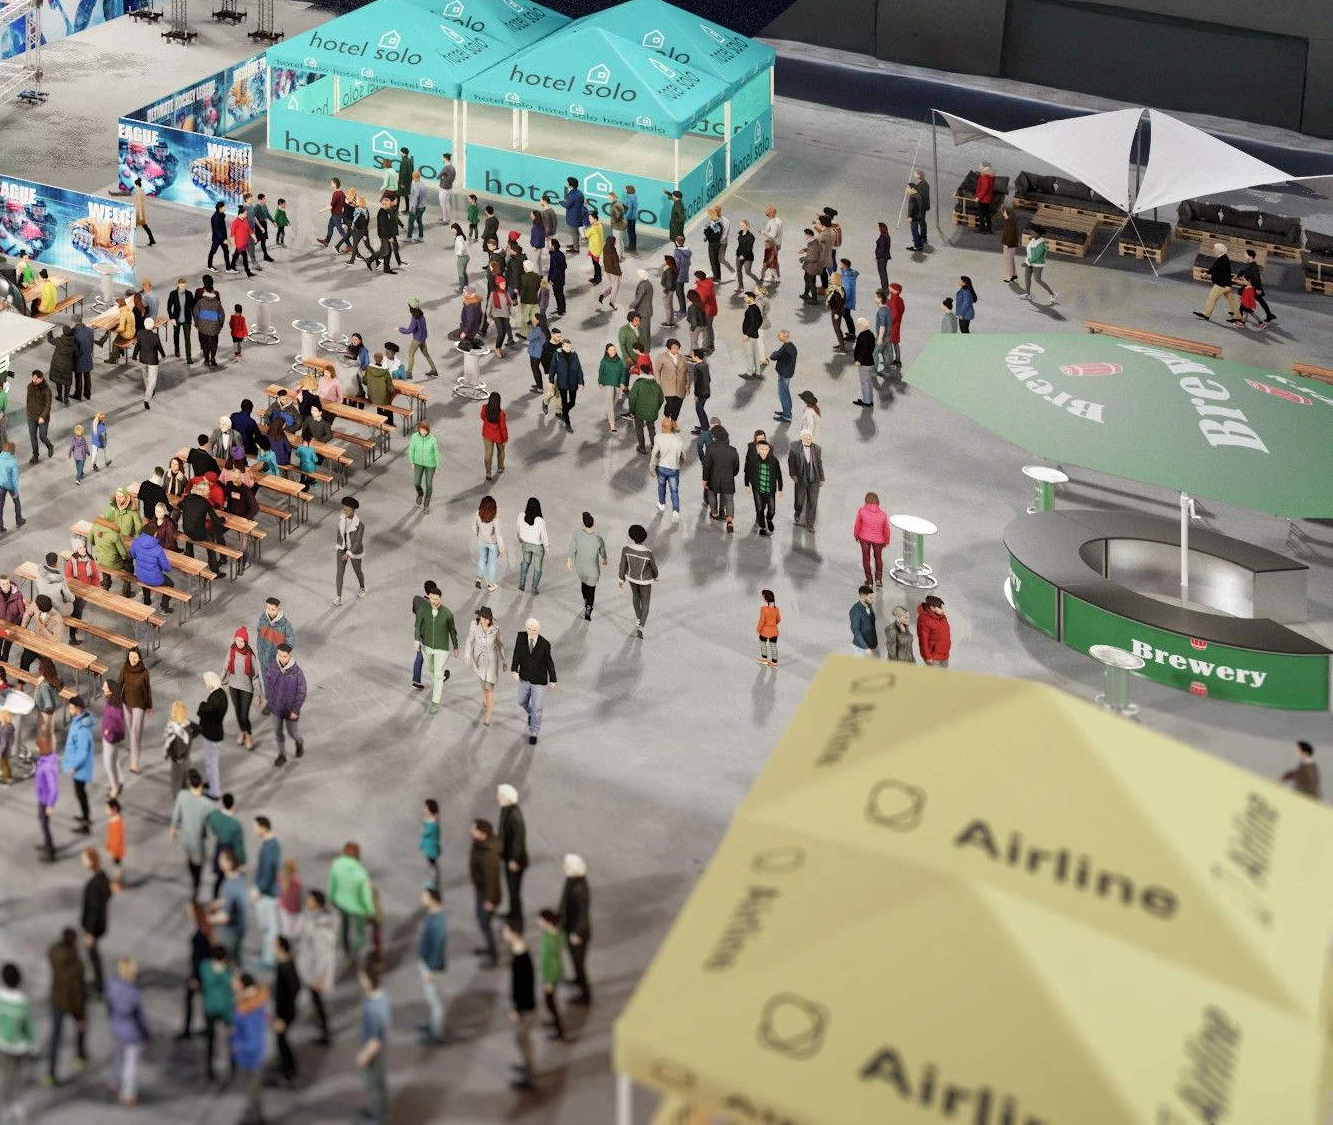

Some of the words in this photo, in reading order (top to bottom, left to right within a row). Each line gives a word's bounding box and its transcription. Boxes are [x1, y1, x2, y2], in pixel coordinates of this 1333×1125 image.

[309, 31, 368, 56] hotel
[374, 47, 422, 65] solo
[277, 59, 305, 69] hotel
[333, 68, 360, 79] hotel
[363, 75, 386, 84] solo
[390, 78, 418, 89] hotel
[422, 85, 446, 95] solo
[509, 64, 576, 93] hotel
[583, 82, 637, 102] solo
[474, 93, 504, 105] hotel
[509, 100, 533, 110] solo
[538, 104, 568, 116] hotel
[573, 113, 598, 122] solo
[603, 117, 634, 129] hotel
[639, 125, 666, 135] solo
[285, 131, 359, 165] hotel
[733, 153, 754, 178] hotel
[754, 134, 770, 160] solo
[706, 173, 724, 202] solo
[588, 197, 658, 226] soo
[1005, 342, 1105, 424] Brewery
[1131, 639, 1267, 688] Brewery
[952, 817, 1180, 919] Airline
[858, 1044, 1048, 1125] Airli
